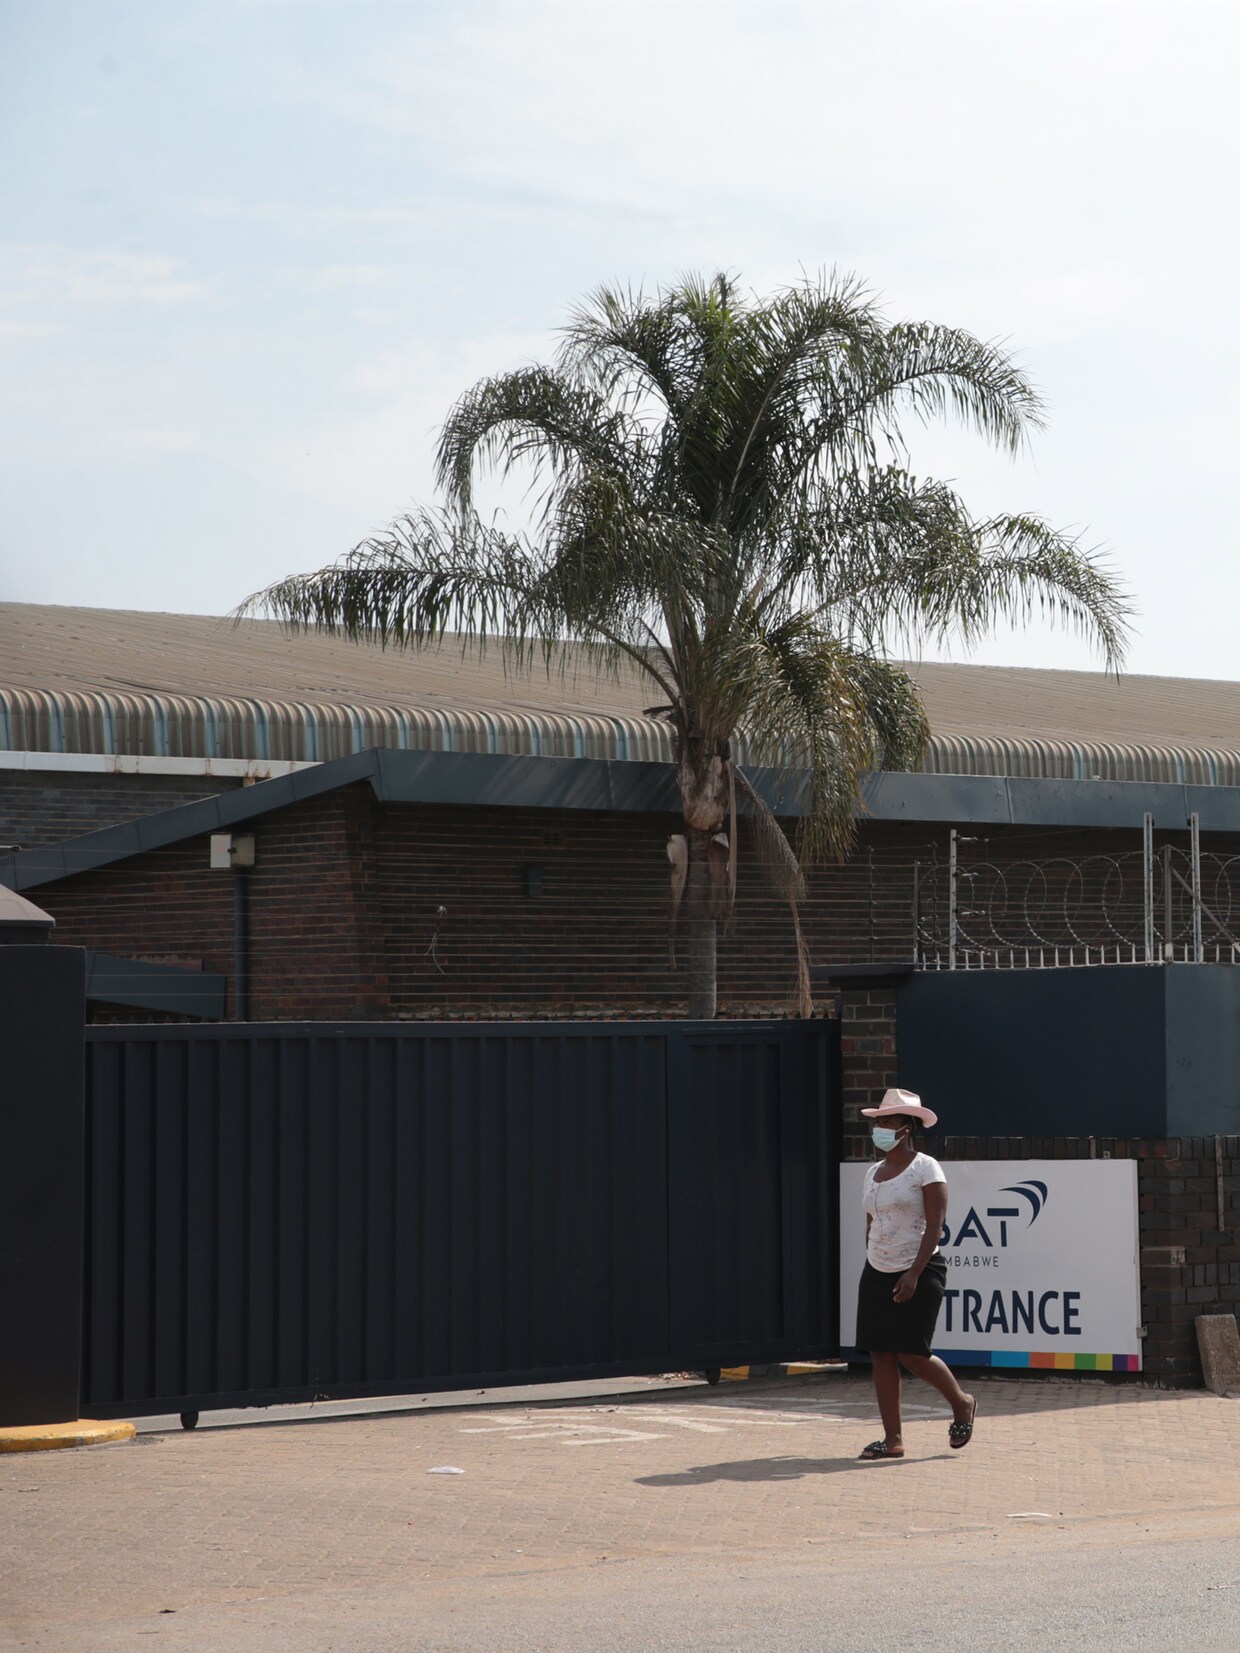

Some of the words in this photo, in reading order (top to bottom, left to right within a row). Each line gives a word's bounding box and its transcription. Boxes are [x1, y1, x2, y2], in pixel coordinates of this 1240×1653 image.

[938, 1205, 1020, 1248] AT
[944, 1255, 1000, 1268] MBABWE
[942, 1288, 1082, 1336] TRANCE
